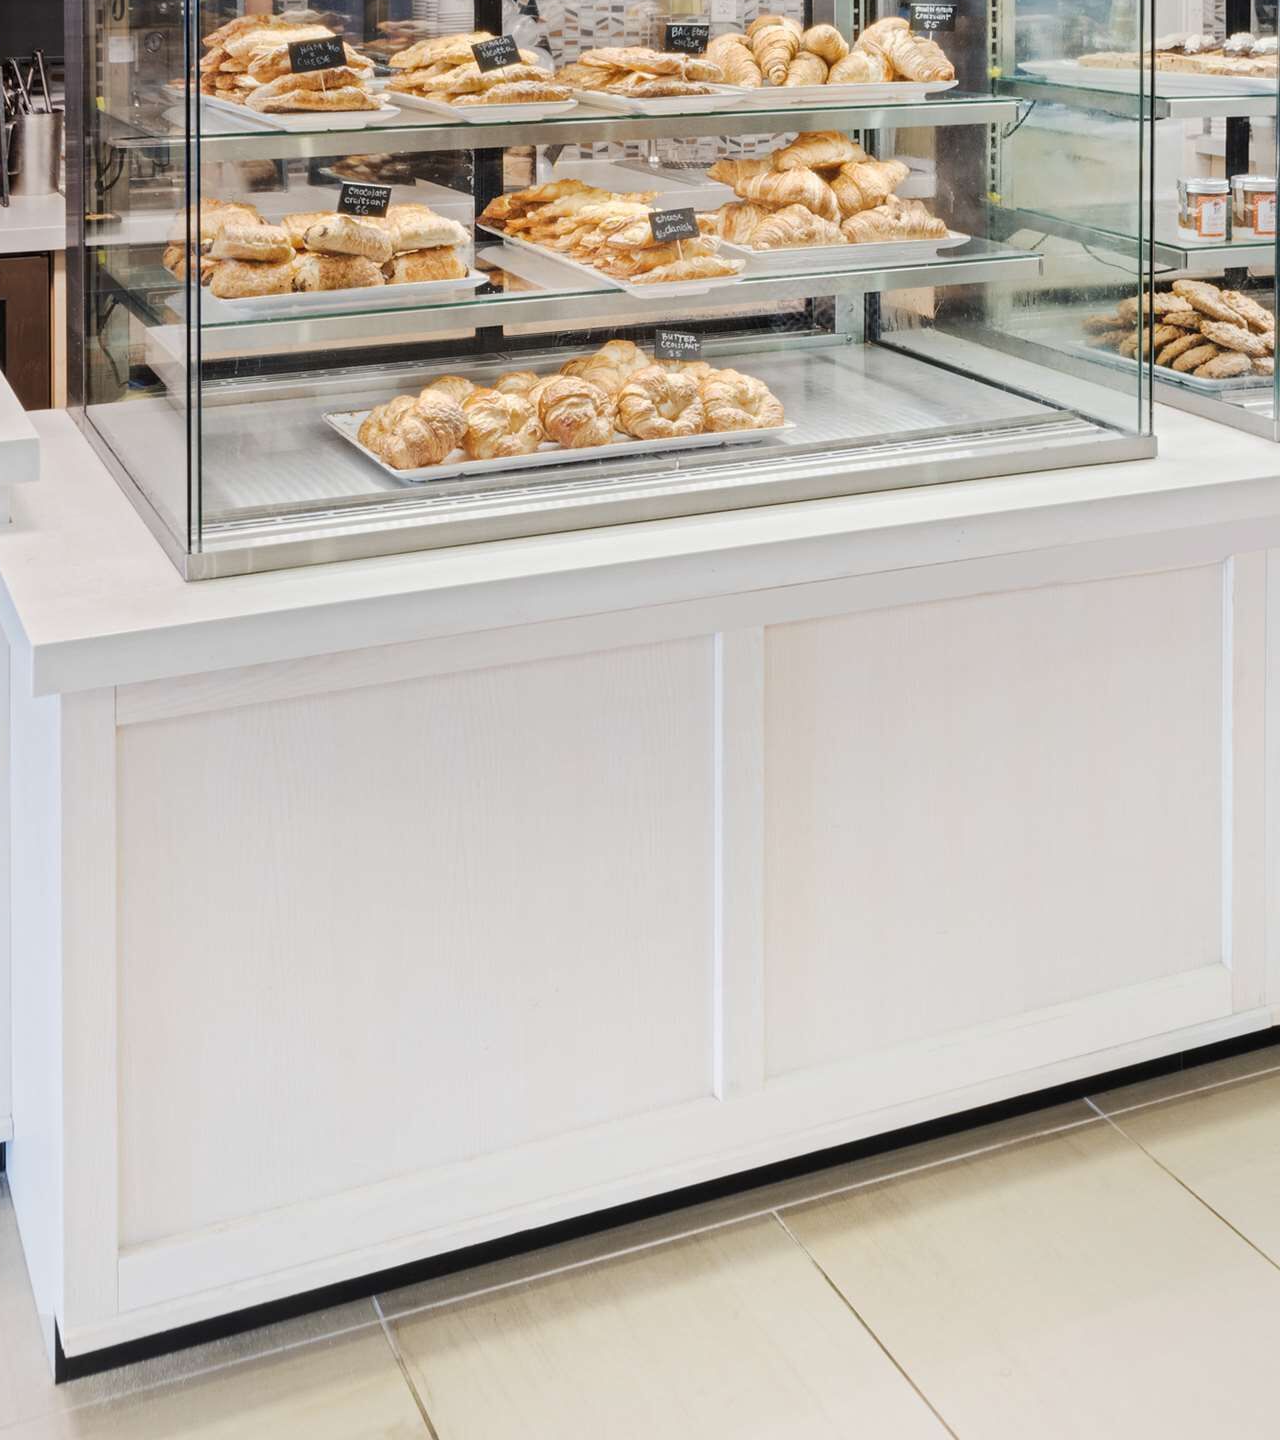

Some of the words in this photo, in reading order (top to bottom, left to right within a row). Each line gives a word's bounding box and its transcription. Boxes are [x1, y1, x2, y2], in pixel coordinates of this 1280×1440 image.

[924, 20, 940, 29] $5
[494, 56, 507, 65] $6
[662, 333, 697, 343] BUTTER
